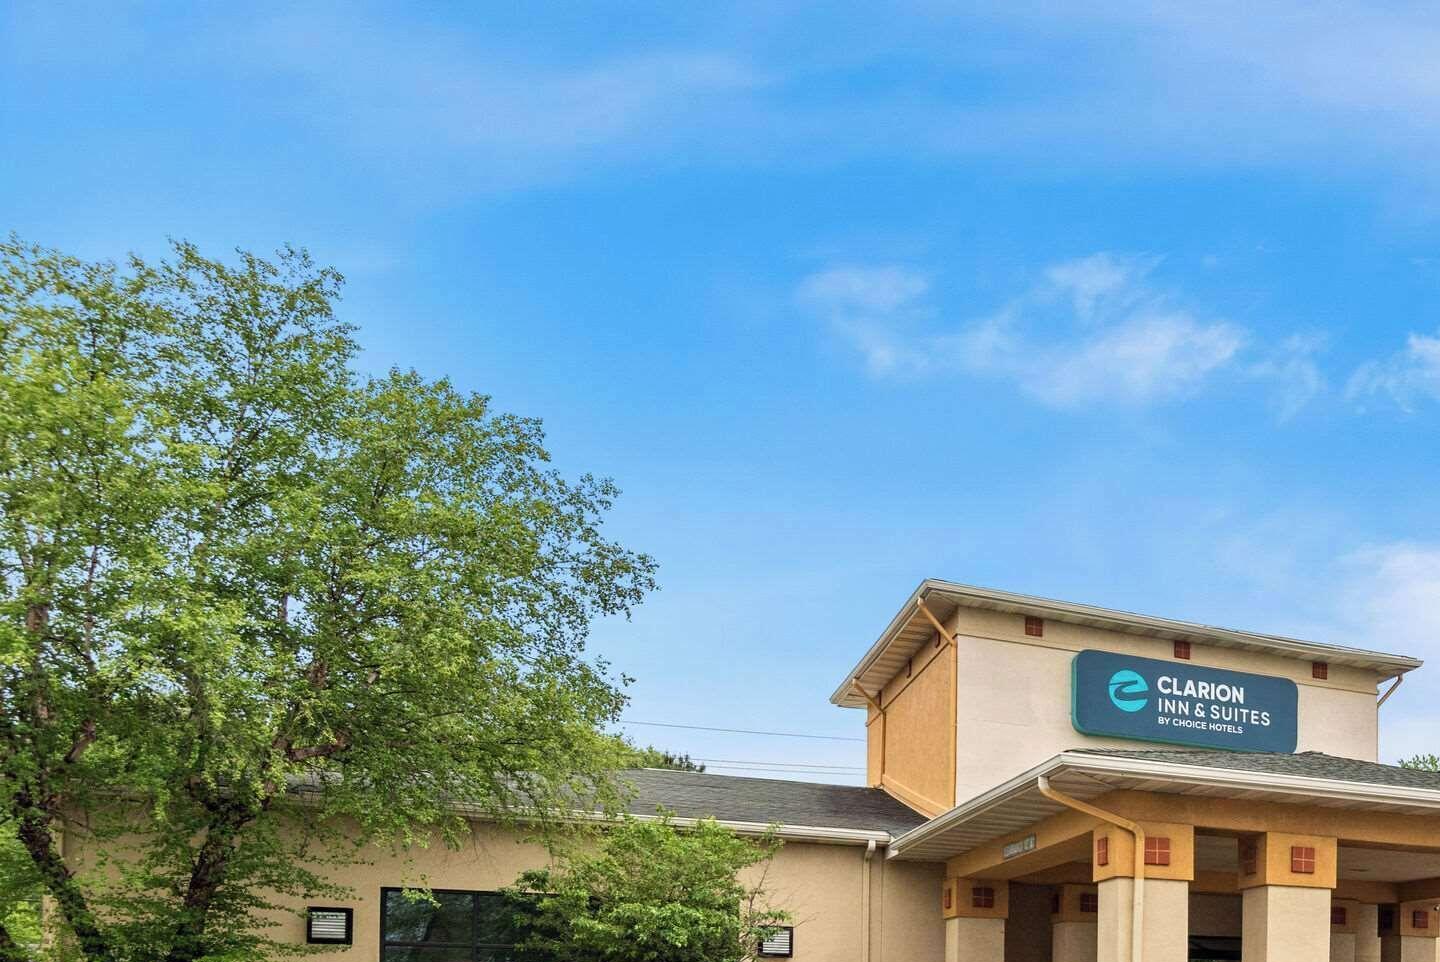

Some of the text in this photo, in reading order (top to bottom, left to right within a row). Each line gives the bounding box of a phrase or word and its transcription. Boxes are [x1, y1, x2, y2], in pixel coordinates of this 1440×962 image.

[1157, 676, 1244, 704] CLARION
[1158, 697, 1271, 727] INN & SUITES
[1158, 716, 1244, 734] BY CHOICE HOTELS
